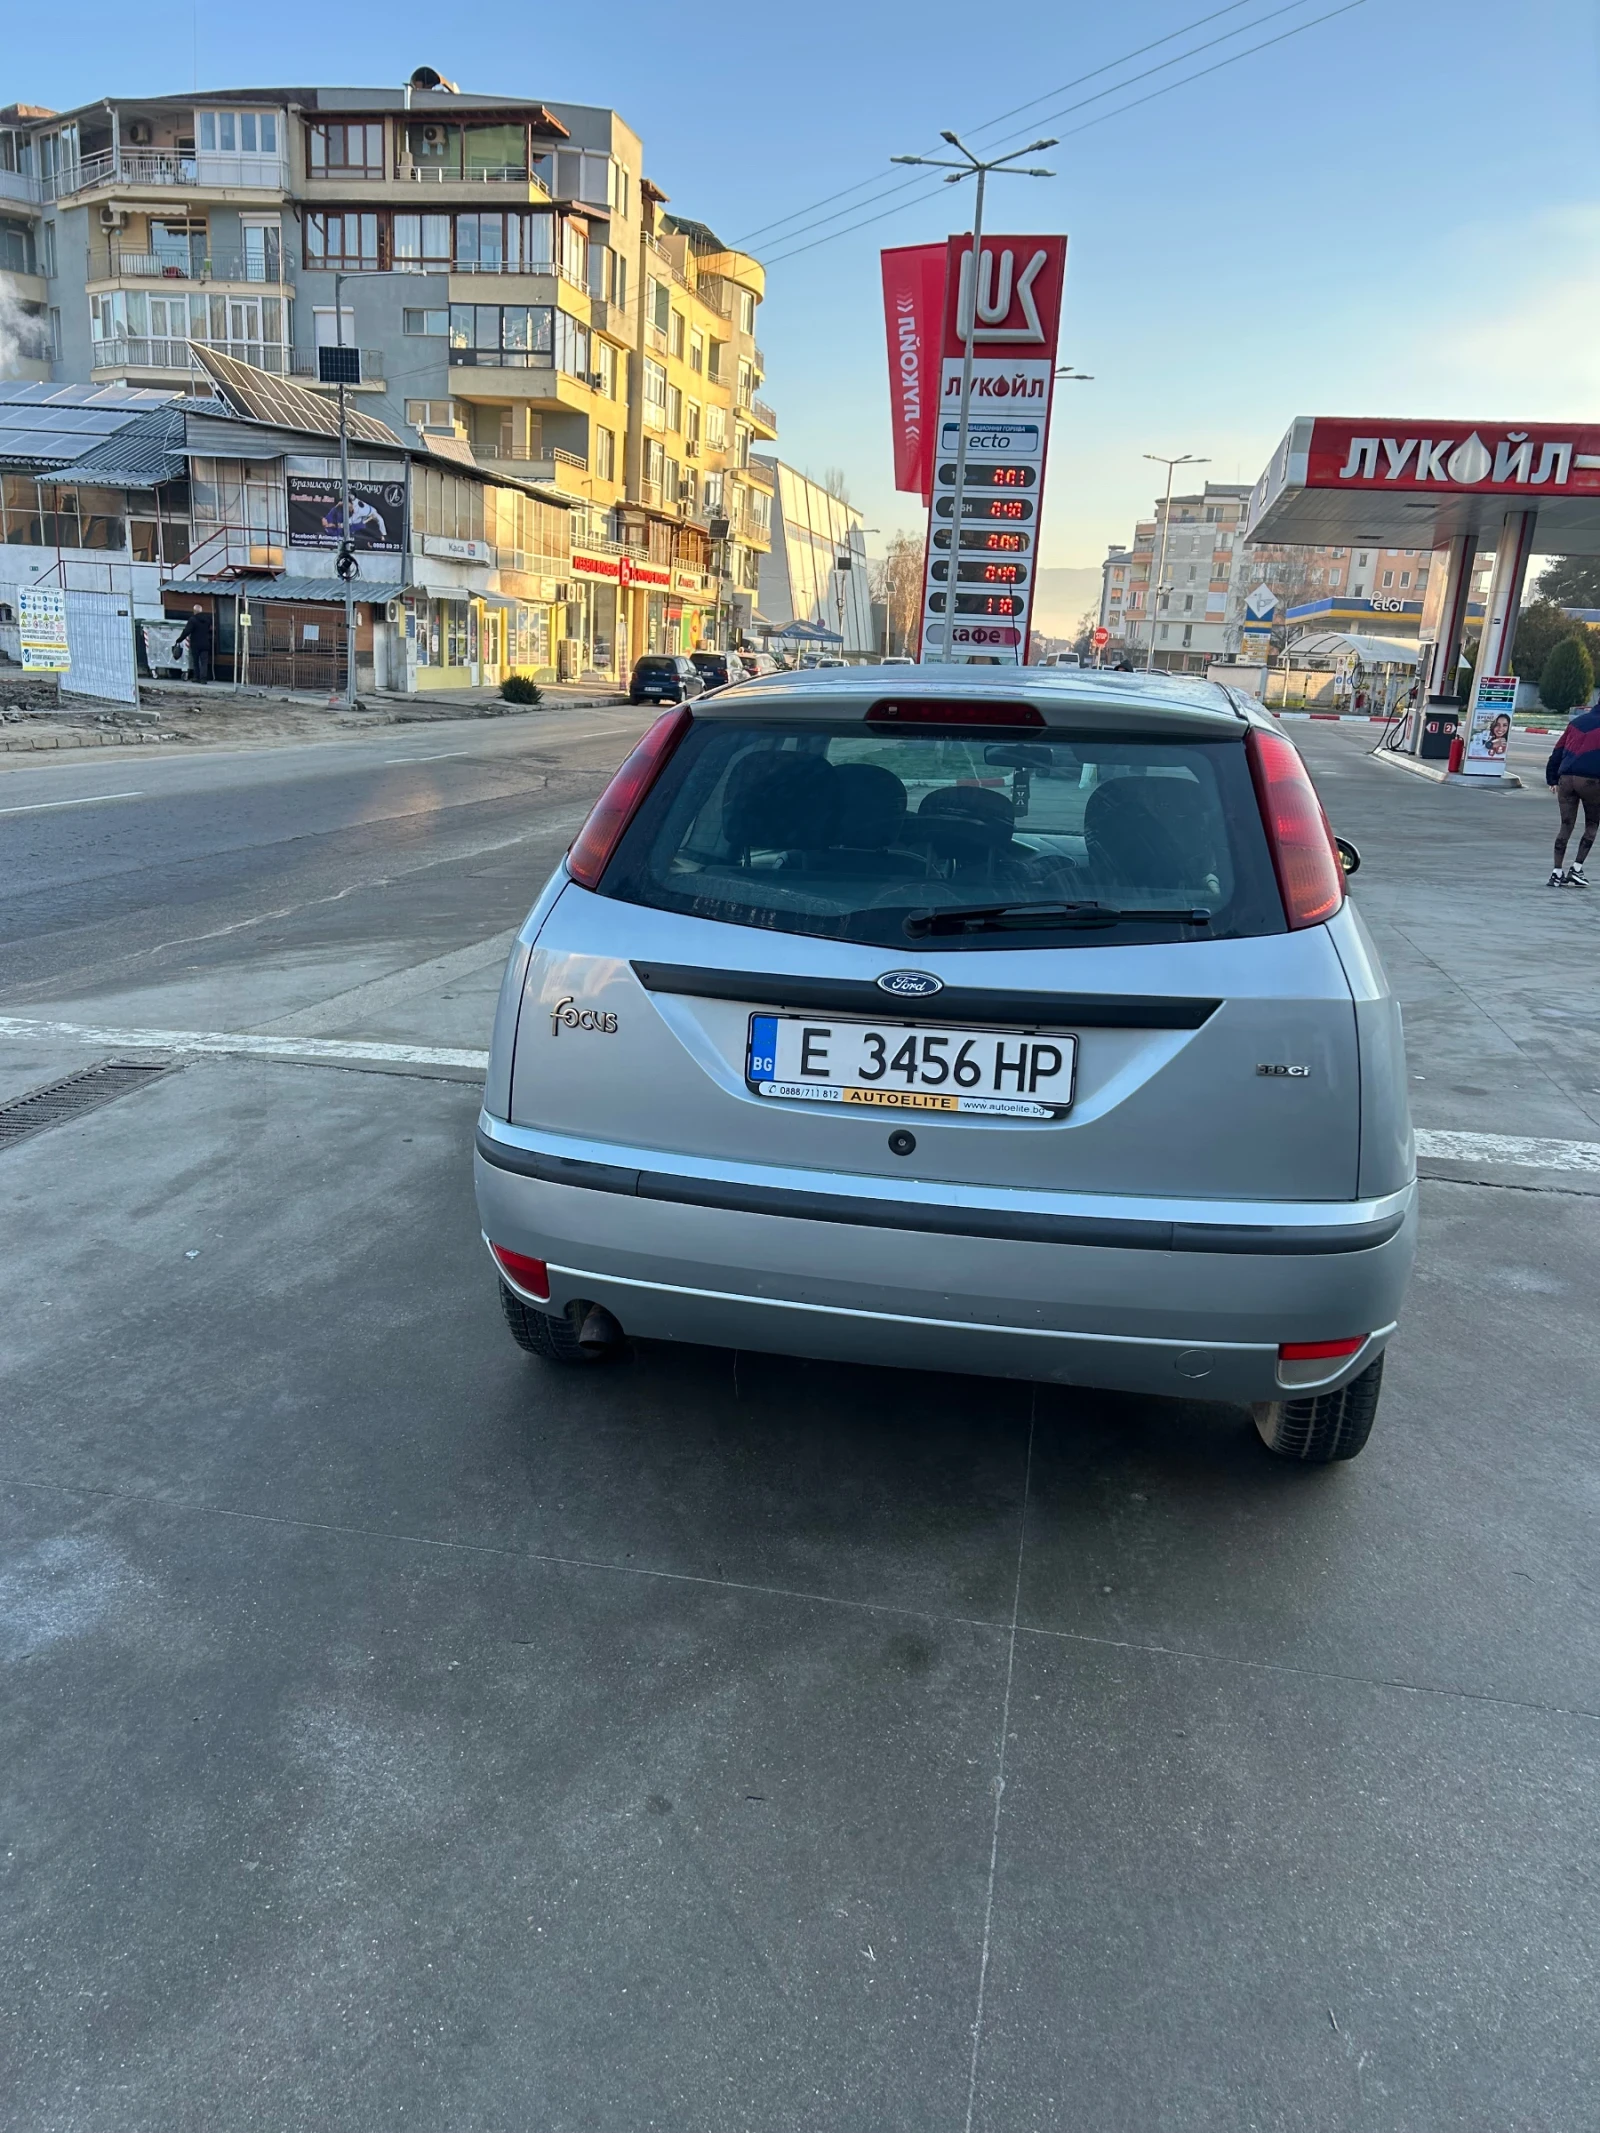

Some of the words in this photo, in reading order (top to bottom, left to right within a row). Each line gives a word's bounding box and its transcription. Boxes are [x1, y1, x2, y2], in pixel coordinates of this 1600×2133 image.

[969, 433, 1011, 449] ecto
[1339, 430, 1574, 485] ЛУКОЙЛ
[951, 471, 967, 480] 10
[291, 478, 332, 491] Бразилско
[940, 598, 960, 608] LG
[1095, 632, 1108, 640] STOP
[892, 976, 927, 991] Ford
[753, 1056, 773, 1072] BG
[800, 1027, 832, 1078] E
[858, 1032, 981, 1088] 3456
[993, 1041, 1062, 1093] HP
[1256, 1063, 1310, 1076] TDCi
[822, 1089, 839, 1099] 812
[850, 1091, 952, 1109] AUTOELITE
[963, 1101, 1046, 1116] www.autoelite.bg
